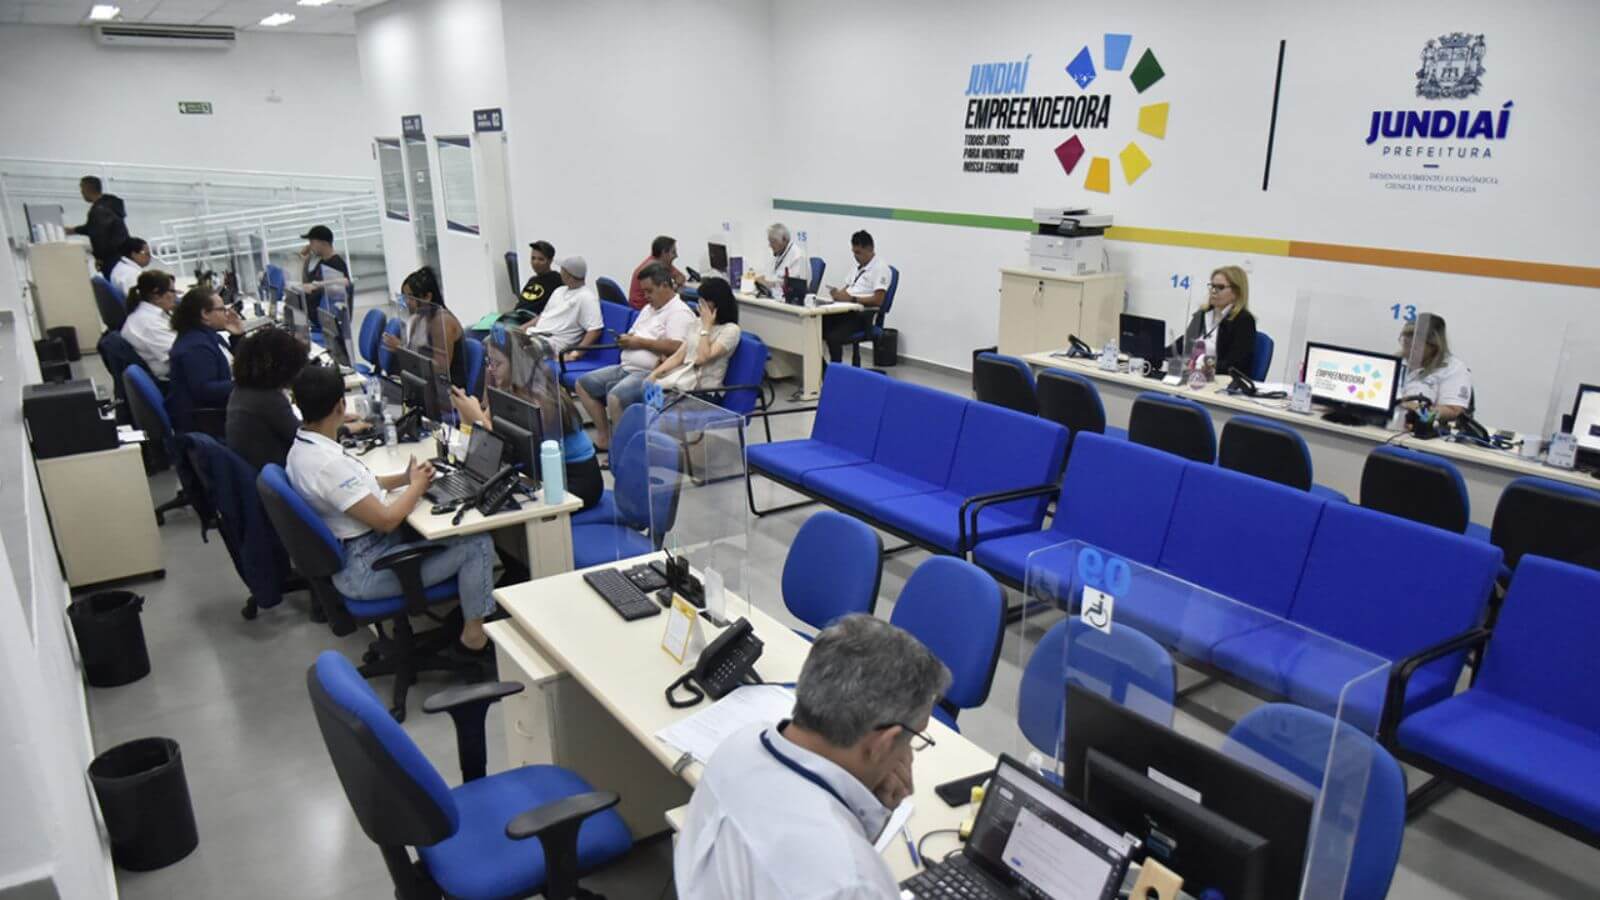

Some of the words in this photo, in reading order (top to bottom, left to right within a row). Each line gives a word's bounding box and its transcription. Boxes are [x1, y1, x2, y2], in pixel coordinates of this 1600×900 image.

[965, 54, 1032, 96] JUNDIAÍ
[965, 94, 1111, 129] EMPREENDEDORA
[1366, 100, 1514, 145] JUNDIAÍ
[965, 134, 985, 146] TODOS
[986, 134, 1011, 146] JUNTOS
[963, 148, 980, 159] PARA
[981, 148, 1025, 160] MOVIMENTAR
[1383, 146, 1492, 158] PREFEITURA
[963, 161, 984, 172] NOSSA
[985, 161, 1019, 174] ECONOMIA
[797, 232, 807, 241] 15
[1171, 275, 1190, 289] 14
[1390, 303, 1417, 322] 13
